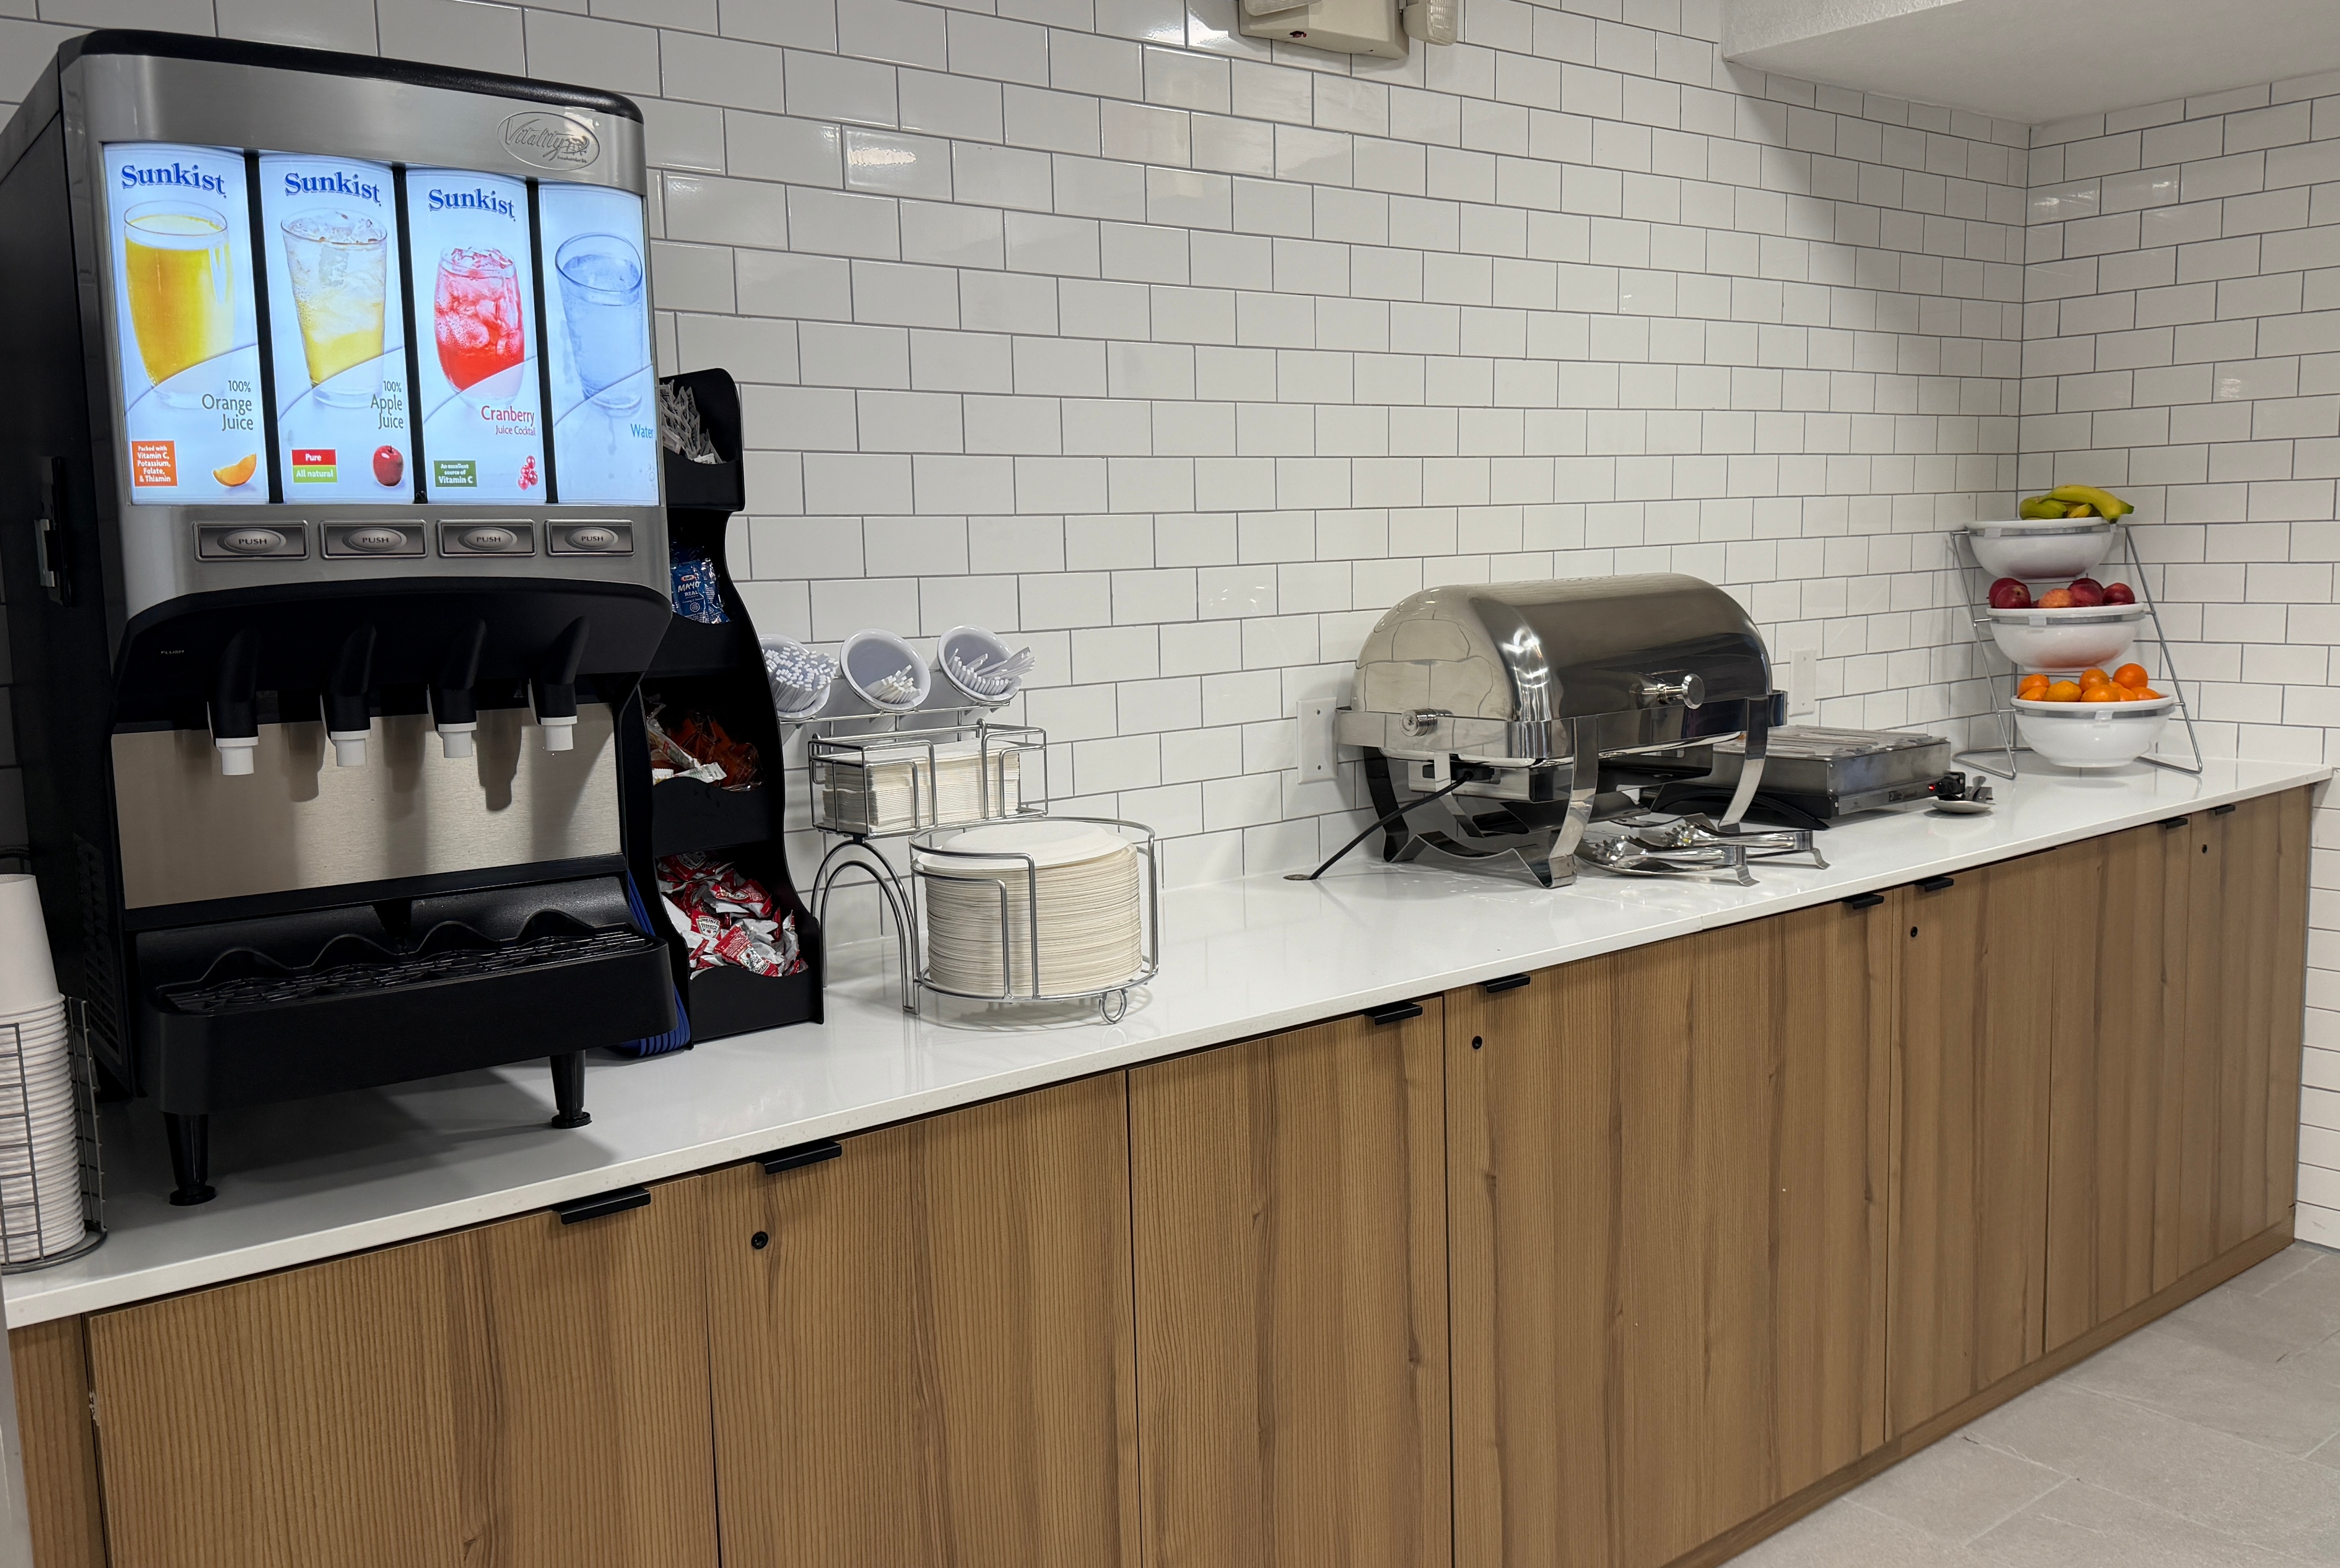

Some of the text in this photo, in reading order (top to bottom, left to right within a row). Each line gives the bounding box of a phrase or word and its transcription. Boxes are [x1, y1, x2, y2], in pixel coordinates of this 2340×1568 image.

[505, 118, 575, 161] Vitality
[121, 163, 227, 199] Sunkist
[284, 171, 382, 207] Sunkist
[428, 188, 516, 222] Sunkist
[228, 380, 251, 393] 100%
[383, 380, 402, 393] 100%
[202, 393, 252, 416] Orange
[370, 394, 402, 414] Apple
[222, 413, 254, 432] Juice
[378, 412, 403, 430] Juice
[481, 405, 534, 427] Cranberry
[495, 425, 536, 436] Juice Cocktail
[630, 423, 653, 439] Water
[137, 459, 171, 467] Potassium,
[305, 453, 322, 462] Pure
[296, 469, 334, 478] All natural
[678, 581, 701, 593] MAYO
